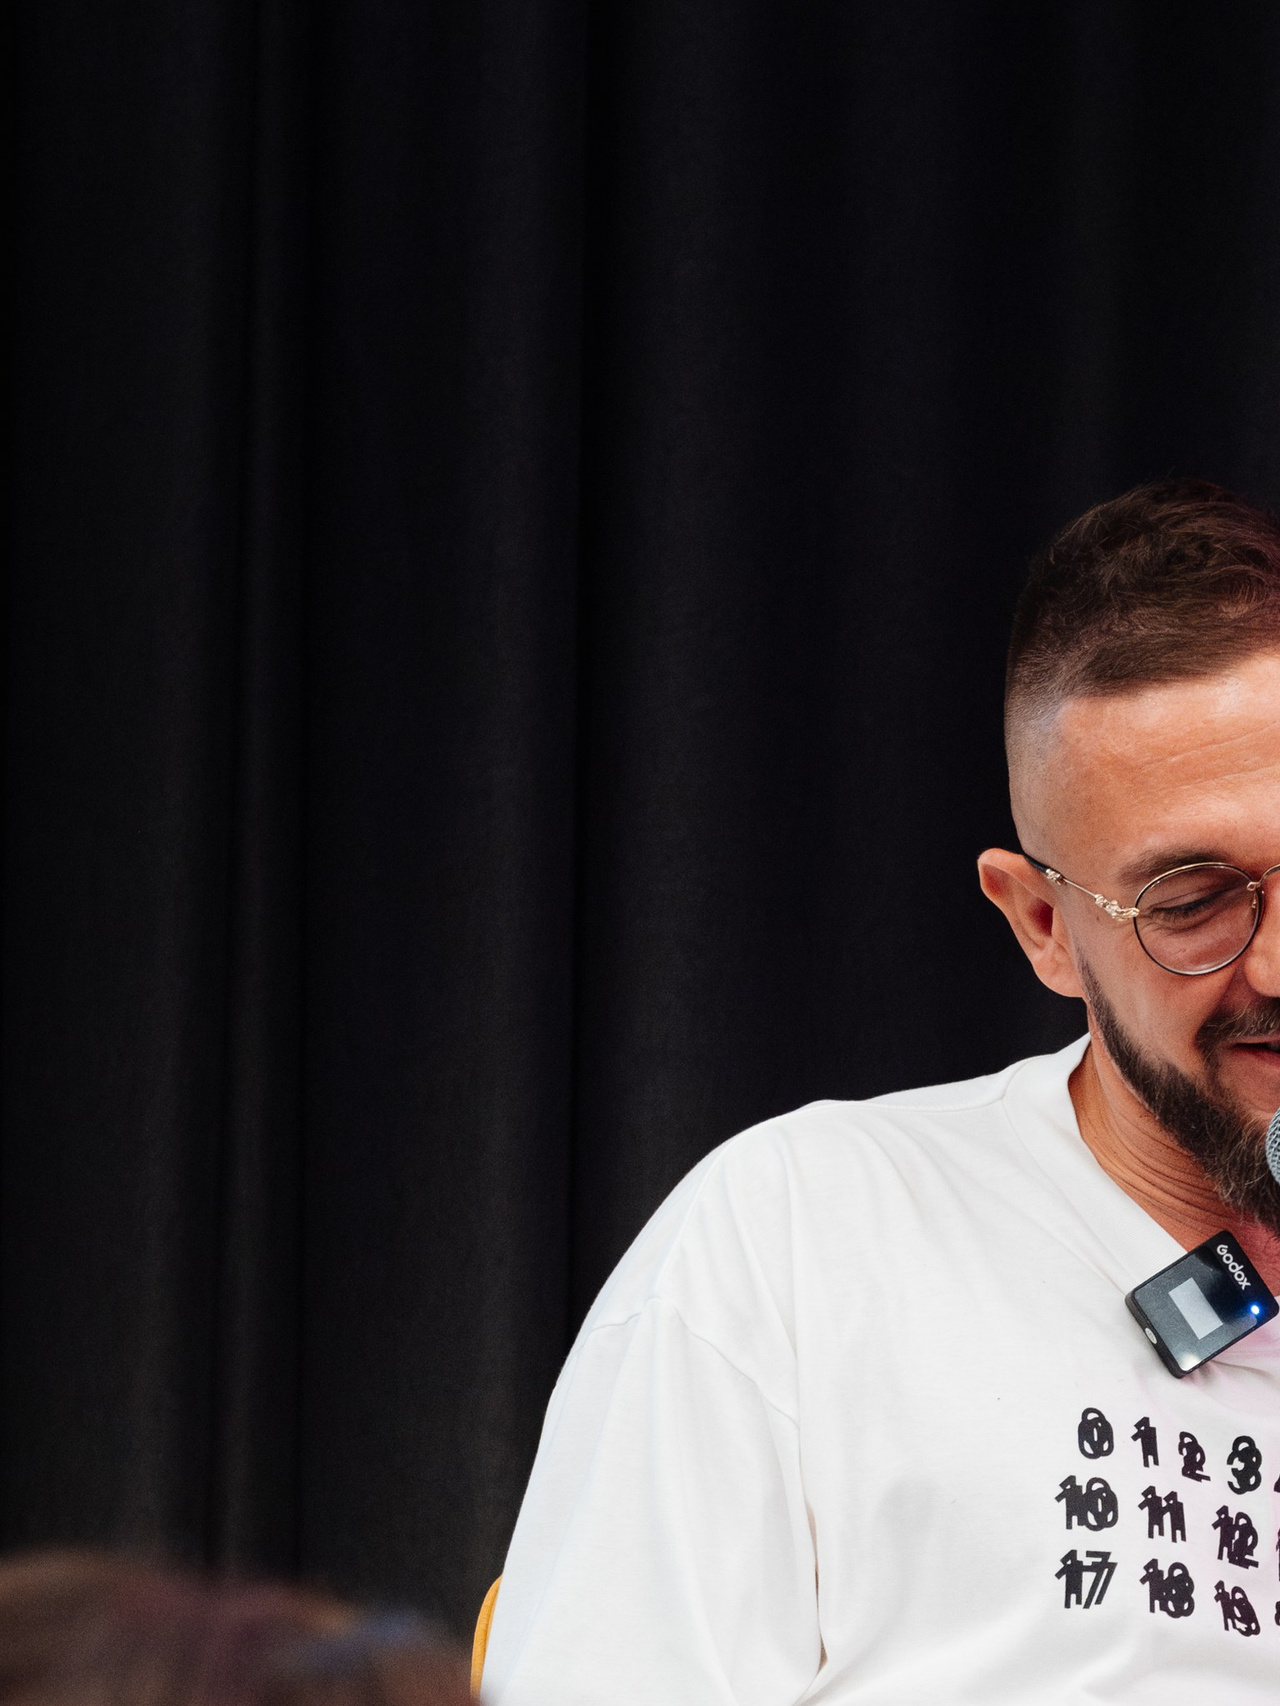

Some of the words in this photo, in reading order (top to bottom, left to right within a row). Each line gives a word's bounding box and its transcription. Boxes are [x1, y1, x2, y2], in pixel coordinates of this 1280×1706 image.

[1216, 1243, 1252, 1291] Godox
[1131, 1416, 1160, 1468] 1
[1178, 1431, 1211, 1483] 2
[1227, 1435, 1263, 1495] 3
[1054, 1475, 1119, 1532] 10
[1137, 1485, 1187, 1543] 11
[1211, 1505, 1260, 1570] 12
[1054, 1549, 1118, 1609] 17
[1139, 1558, 1195, 1619] 18
[1214, 1580, 1261, 1637] 19
